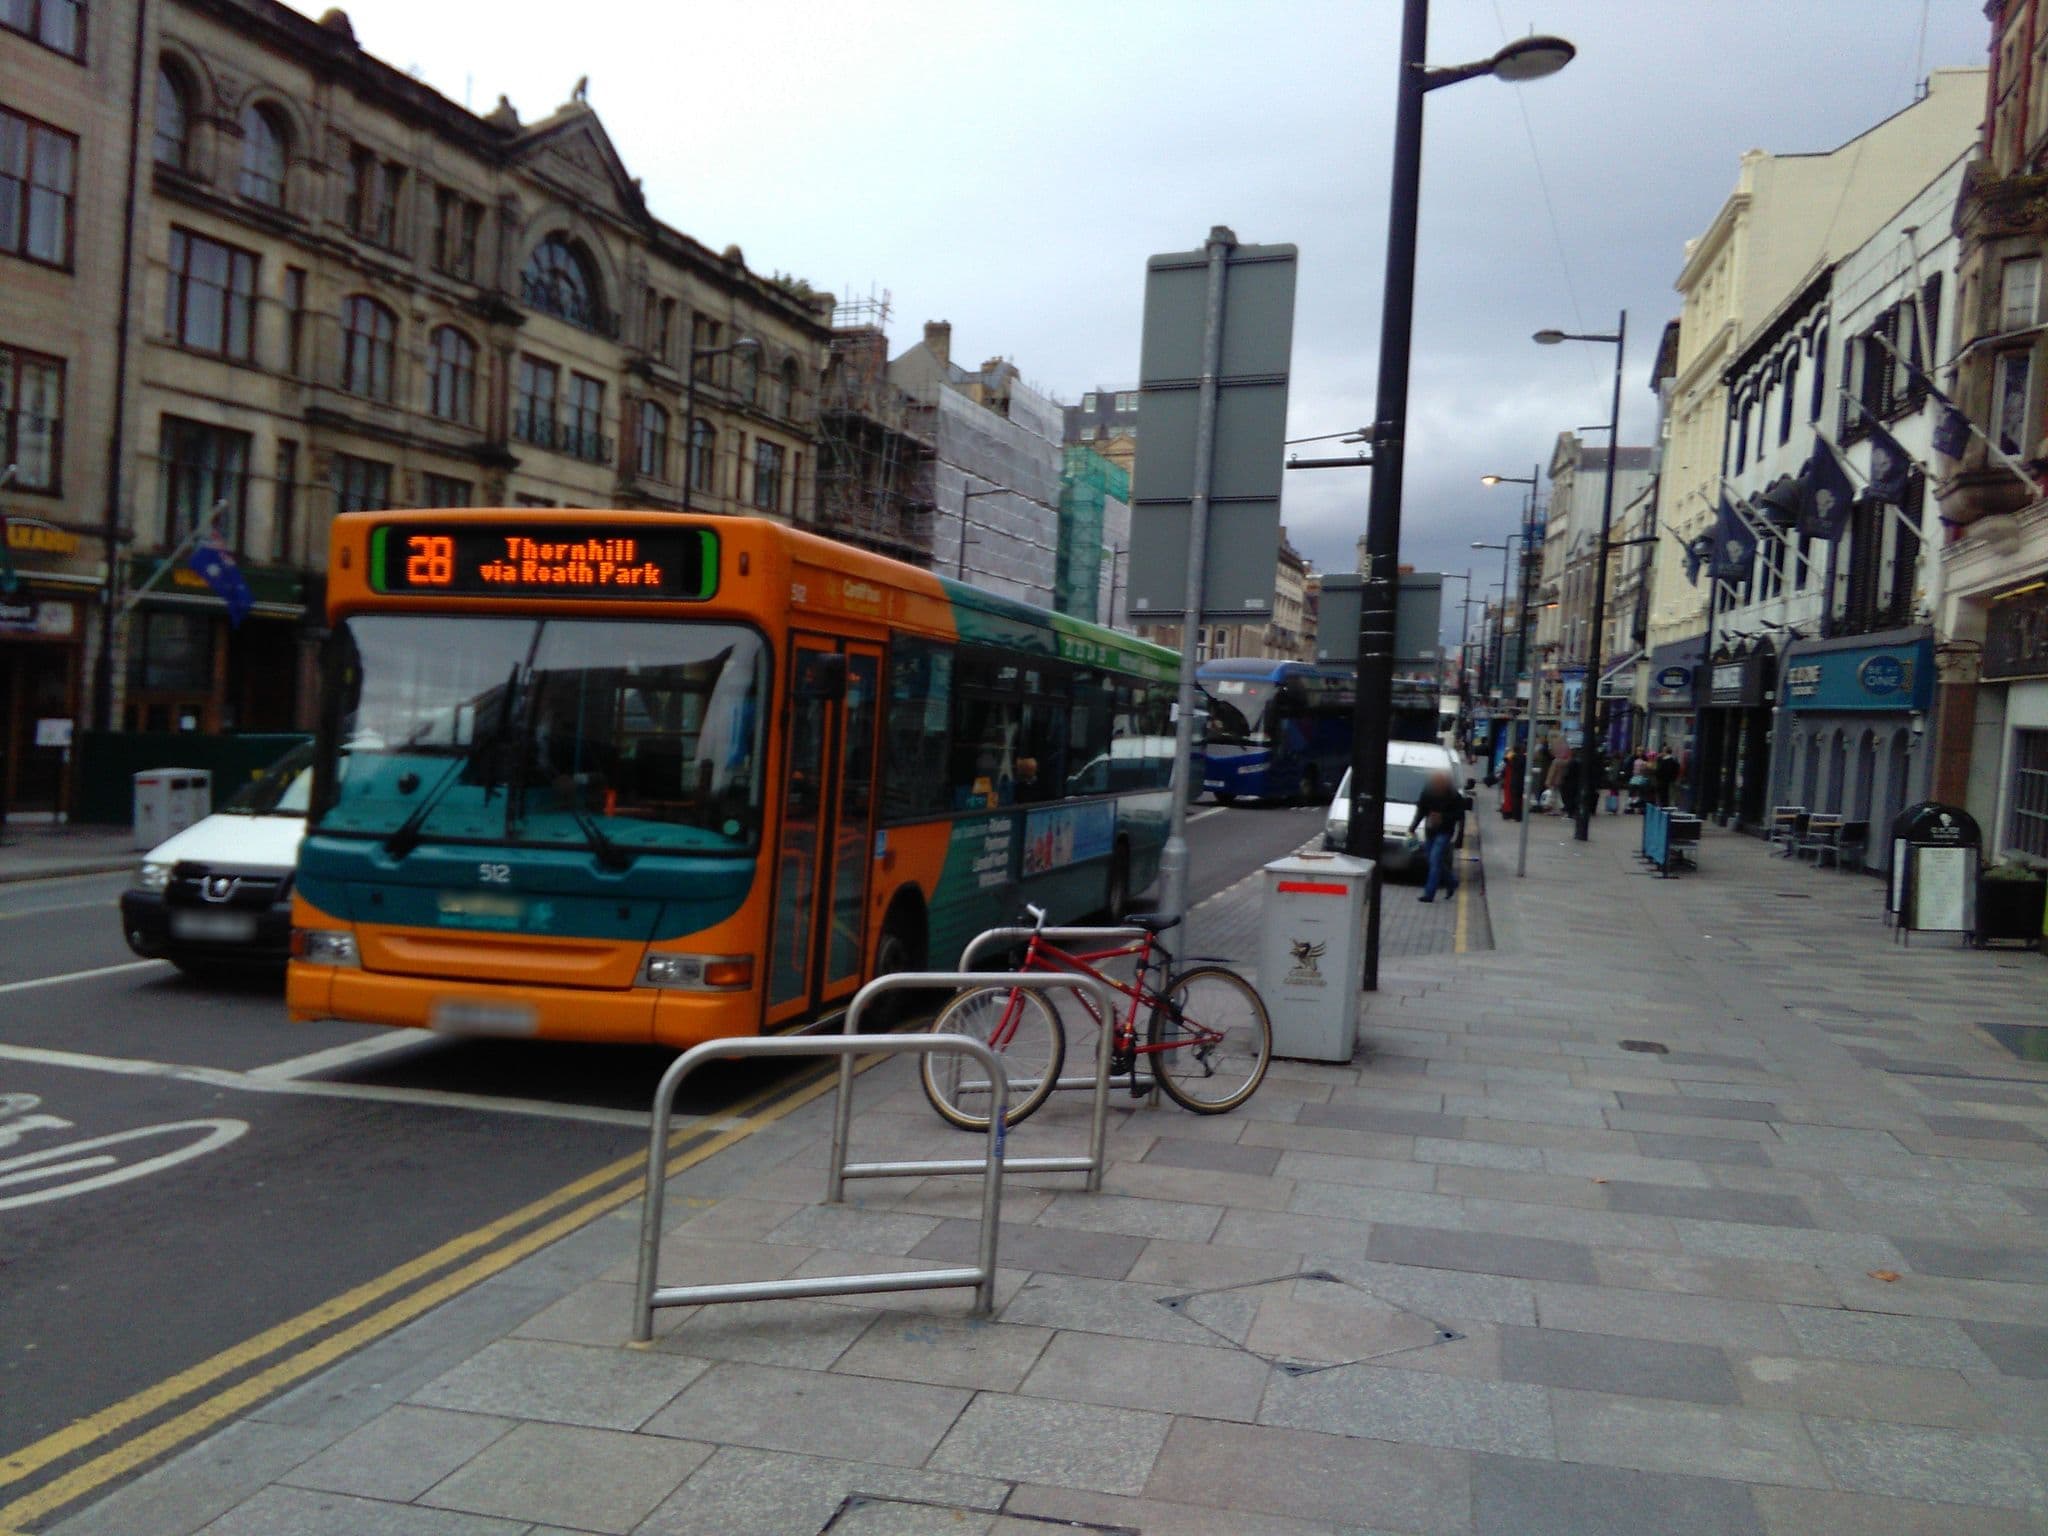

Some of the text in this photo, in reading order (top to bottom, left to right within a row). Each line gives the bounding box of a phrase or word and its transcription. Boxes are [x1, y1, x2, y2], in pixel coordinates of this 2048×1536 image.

[408, 536, 452, 584] 28
[504, 537, 634, 561] Thornhill
[479, 560, 661, 584] via Roath Park
[479, 863, 511, 883] 512
